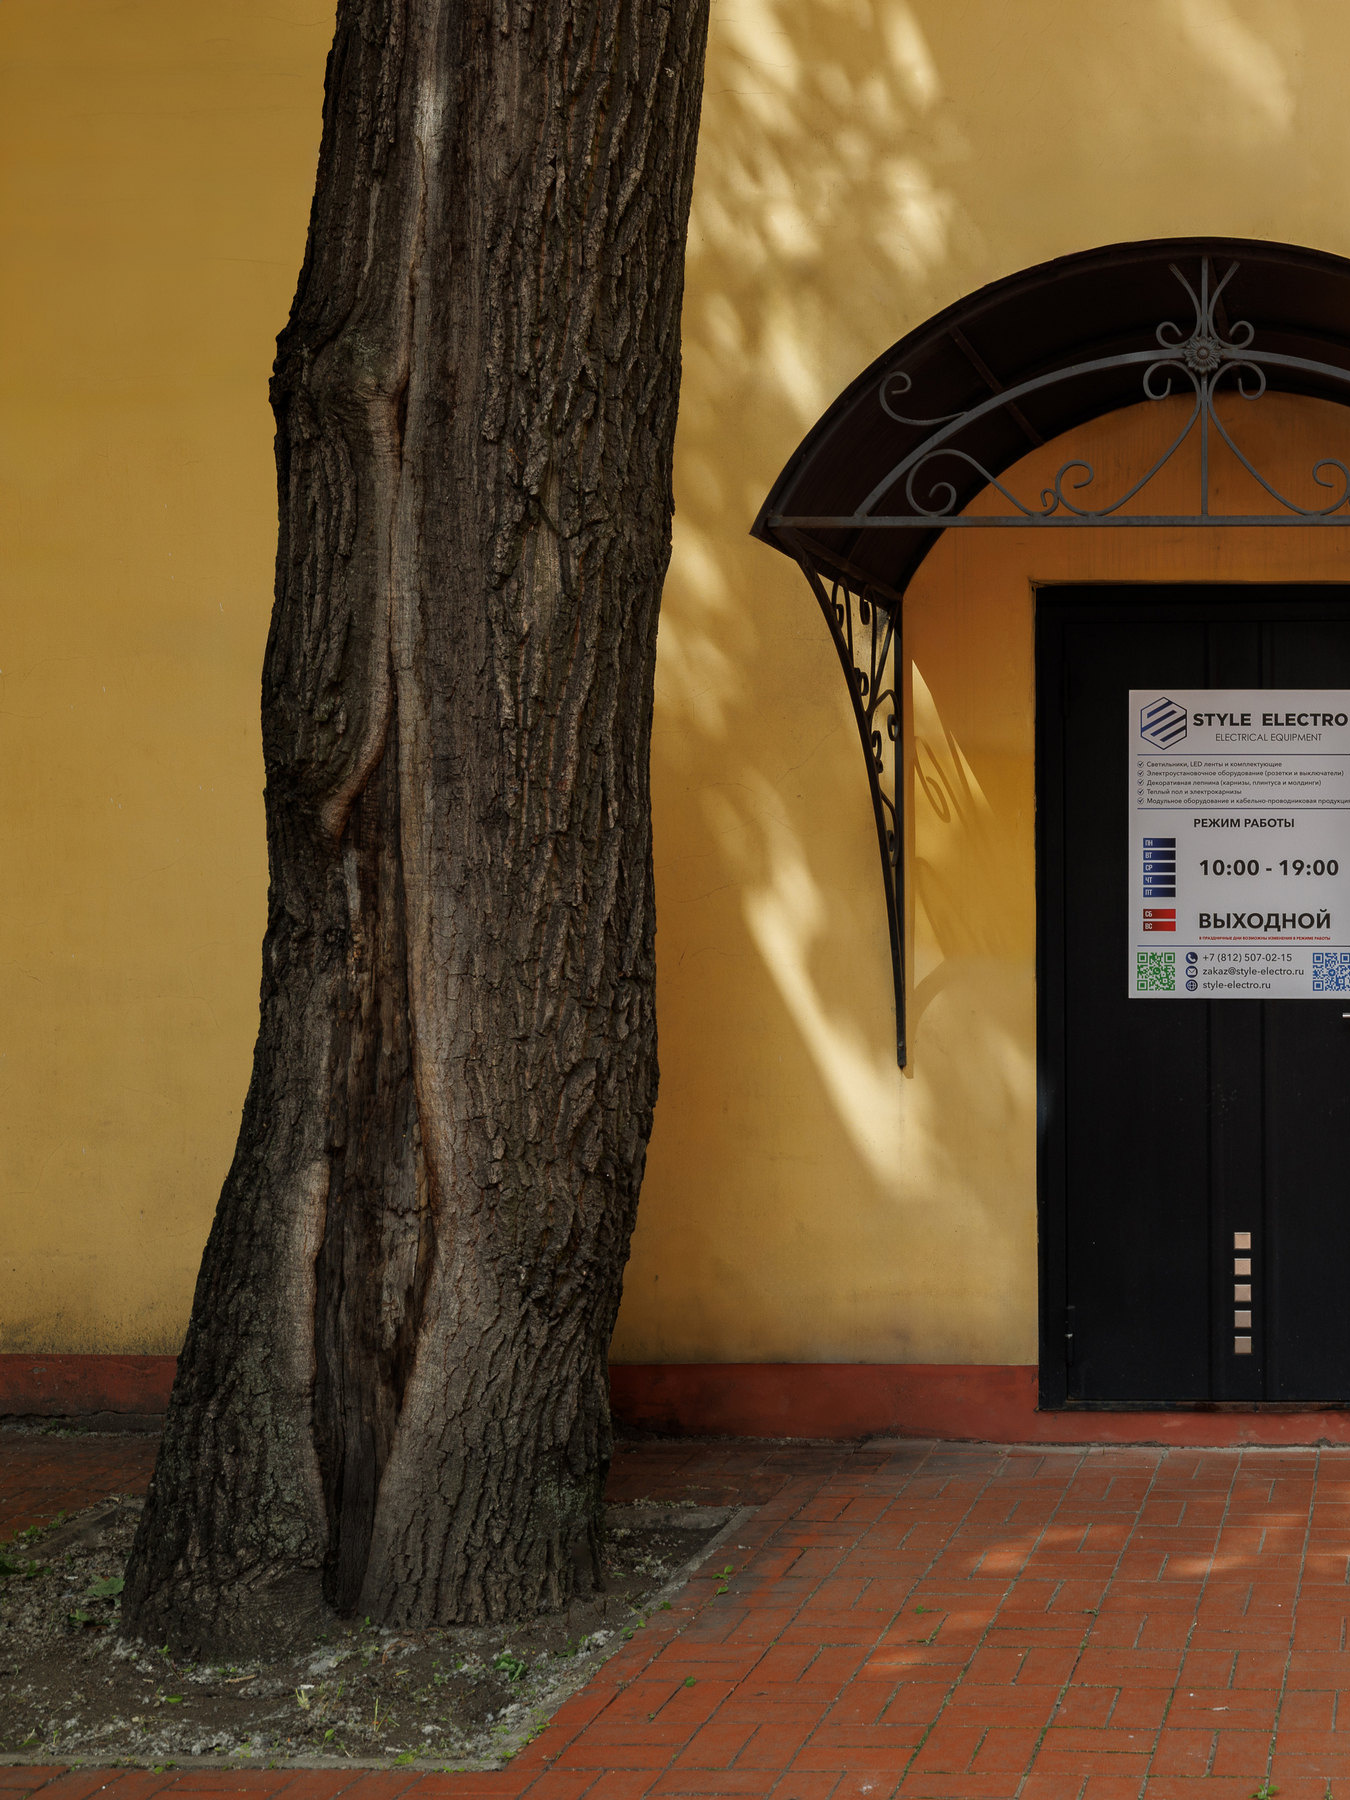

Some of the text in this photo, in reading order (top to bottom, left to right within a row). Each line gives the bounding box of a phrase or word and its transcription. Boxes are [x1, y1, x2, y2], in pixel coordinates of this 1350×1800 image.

[1192, 712, 1349, 727] STYLE ELECTRO
[1215, 733, 1323, 742] ELECTRICAL EQUIPMENT
[1146, 760, 1189, 768] Светильники,
[1190, 760, 1203, 768] LED
[1230, 761, 1282, 769] комплектующие
[1287, 779, 1322, 787] молдинги)
[1193, 818, 1295, 828] РЕЖИМ РАБОТЫ
[1144, 839, 1153, 847] ПН
[1199, 859, 1260, 876] 10:00
[1279, 859, 1339, 876] 19:00
[1199, 908, 1331, 932] ВЫХОДНОЙ
[1203, 952, 1293, 963] +7 (812) 507-02-15
[1203, 965, 1305, 977] zakaz@style-electro.ru
[1203, 979, 1271, 991] style-electro.ru
